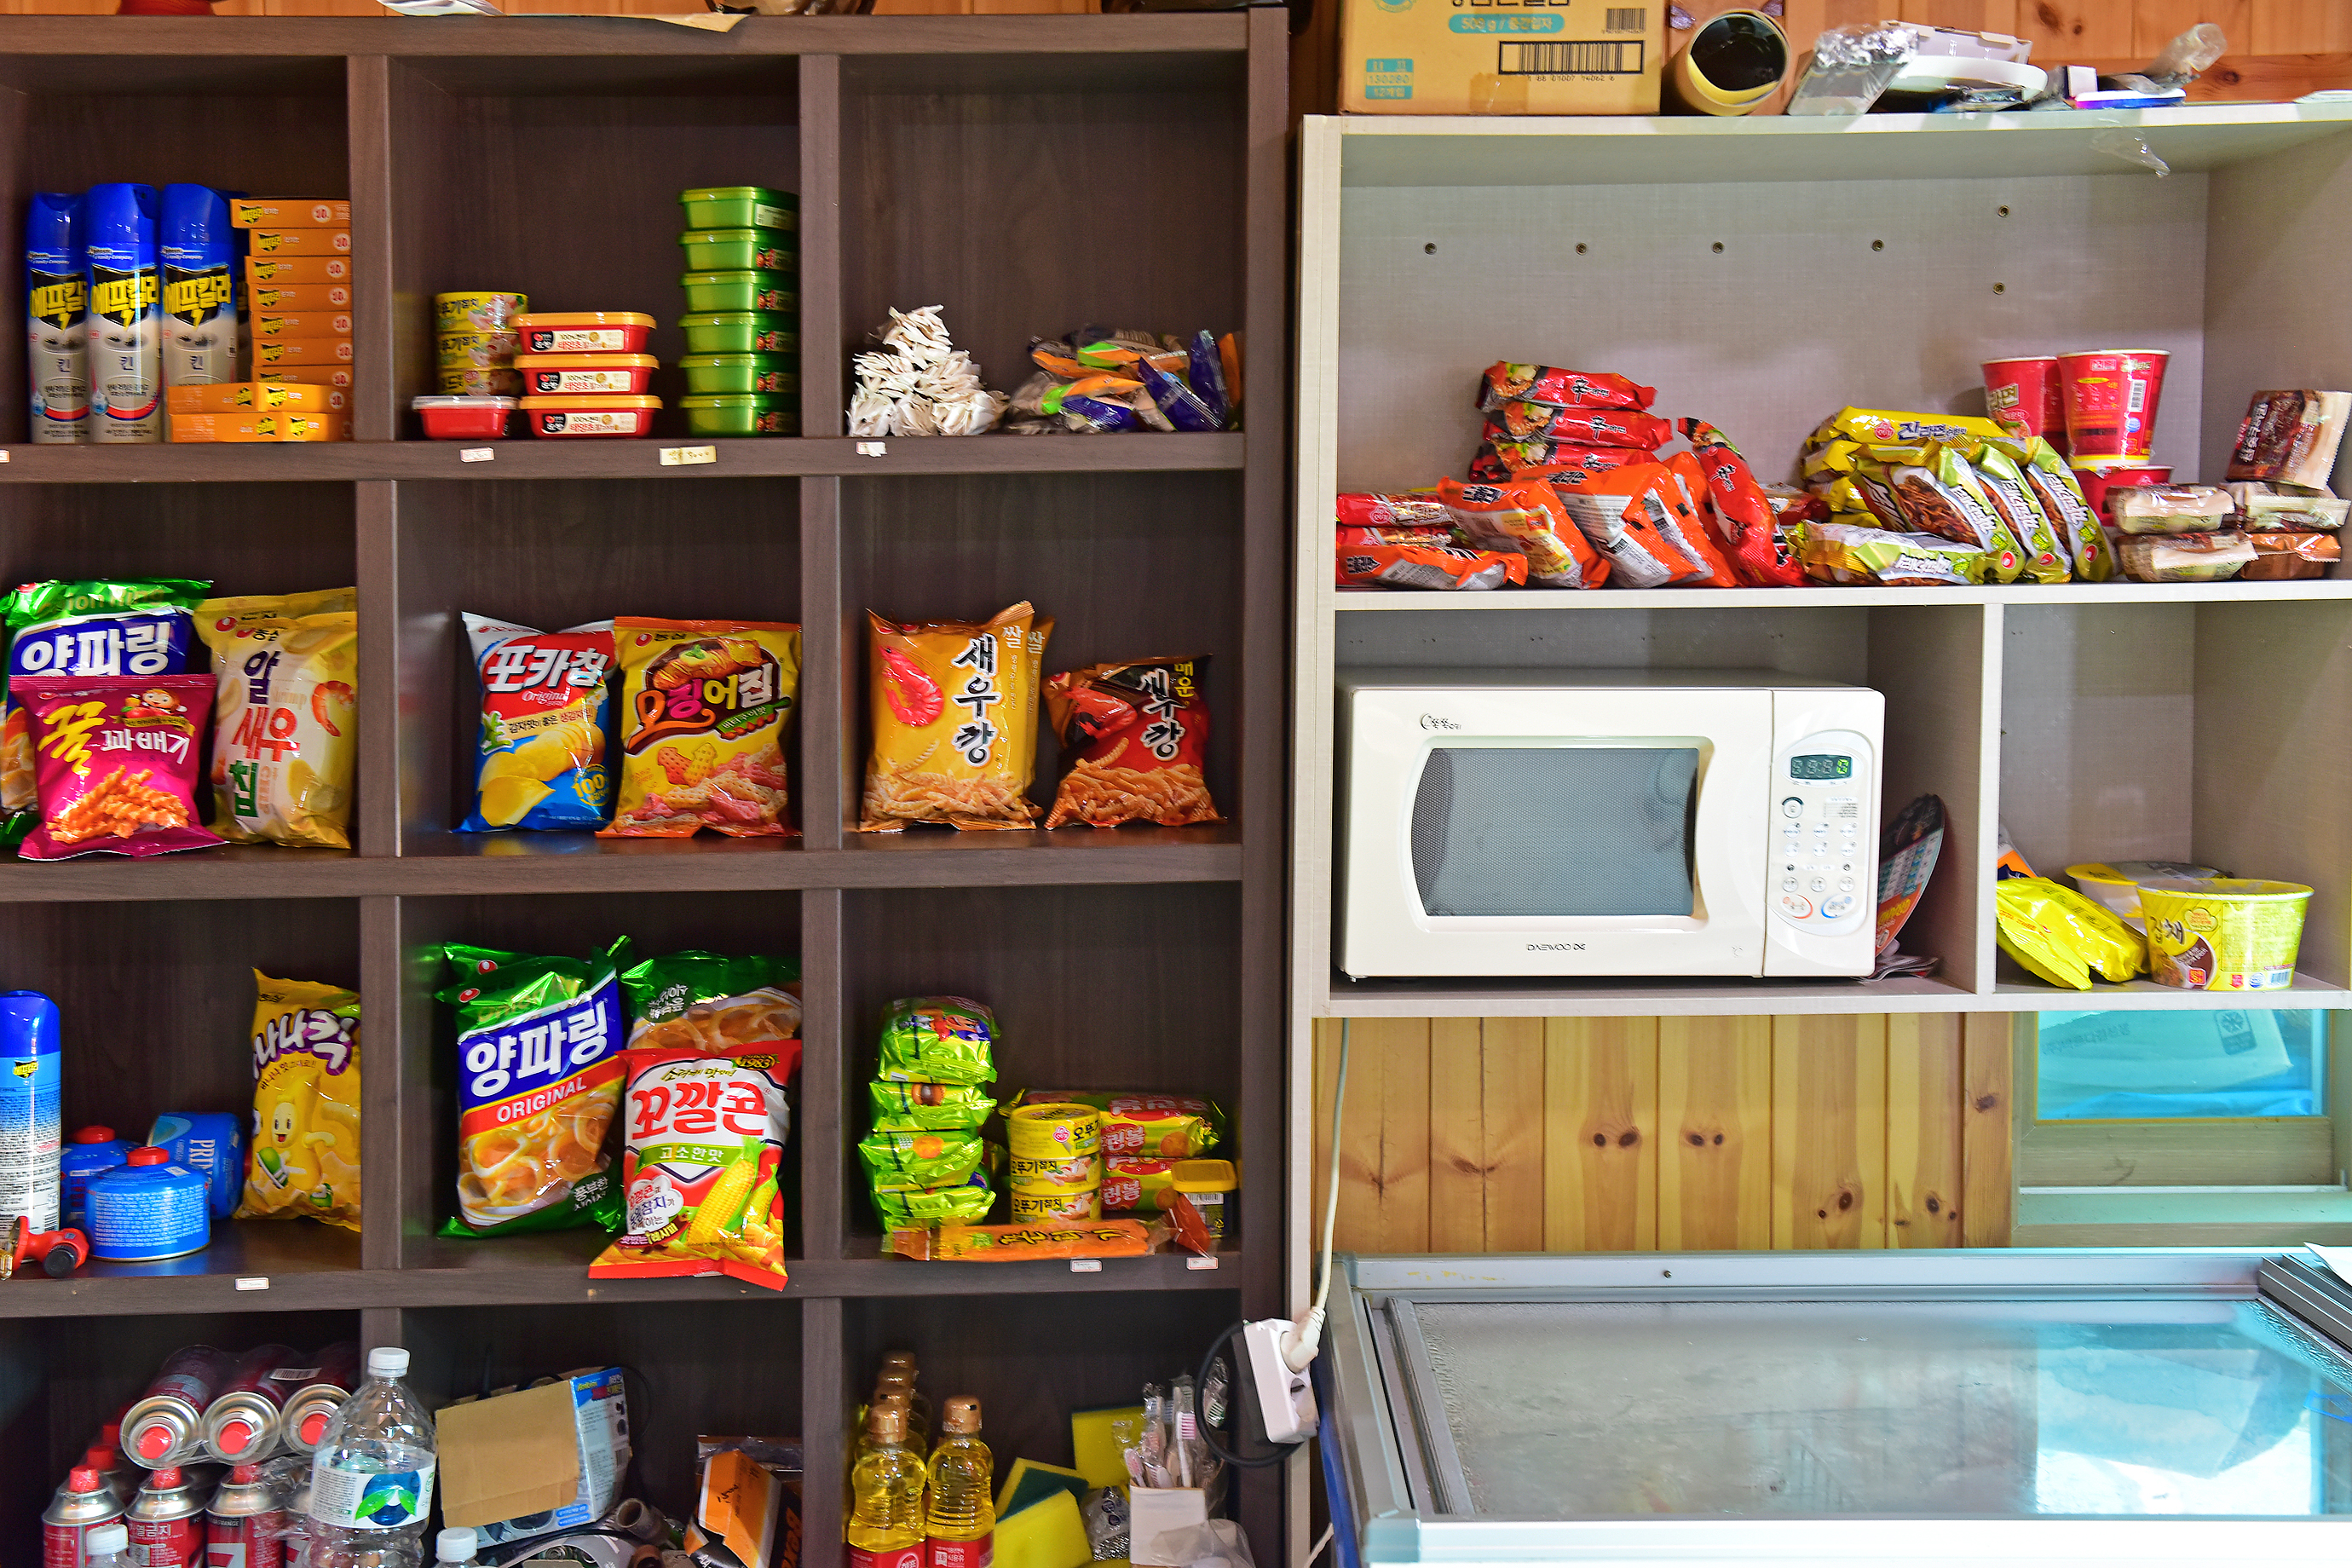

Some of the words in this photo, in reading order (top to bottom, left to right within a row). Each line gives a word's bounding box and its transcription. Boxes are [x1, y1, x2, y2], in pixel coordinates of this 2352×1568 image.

[29, 280, 88, 318] 에프킬
[90, 274, 160, 314] 에프킬라
[163, 273, 232, 314] 에프킬라
[56, 358, 71, 372] 킨
[118, 355, 134, 371] 킨
[189, 355, 205, 371] 킨
[20, 621, 171, 677] 양파링
[1001, 625, 1023, 649] 쌀
[1026, 631, 1046, 654] 쌀
[486, 644, 610, 695] 포카칩
[1174, 660, 1195, 698] 매운
[951, 632, 1004, 768] 새우깡
[37, 700, 108, 777] 꿀
[101, 729, 191, 765] 꽈배기
[1526, 943, 1572, 952] DAEWOO
[253, 1010, 355, 1081] 나나킥
[465, 1000, 608, 1098] 양파링
[741, 1056, 771, 1069] 1983
[496, 1076, 587, 1123] ORIGINAL
[631, 1081, 769, 1140] 꼬깔콘
[574, 1175, 608, 1202] 풍부한
